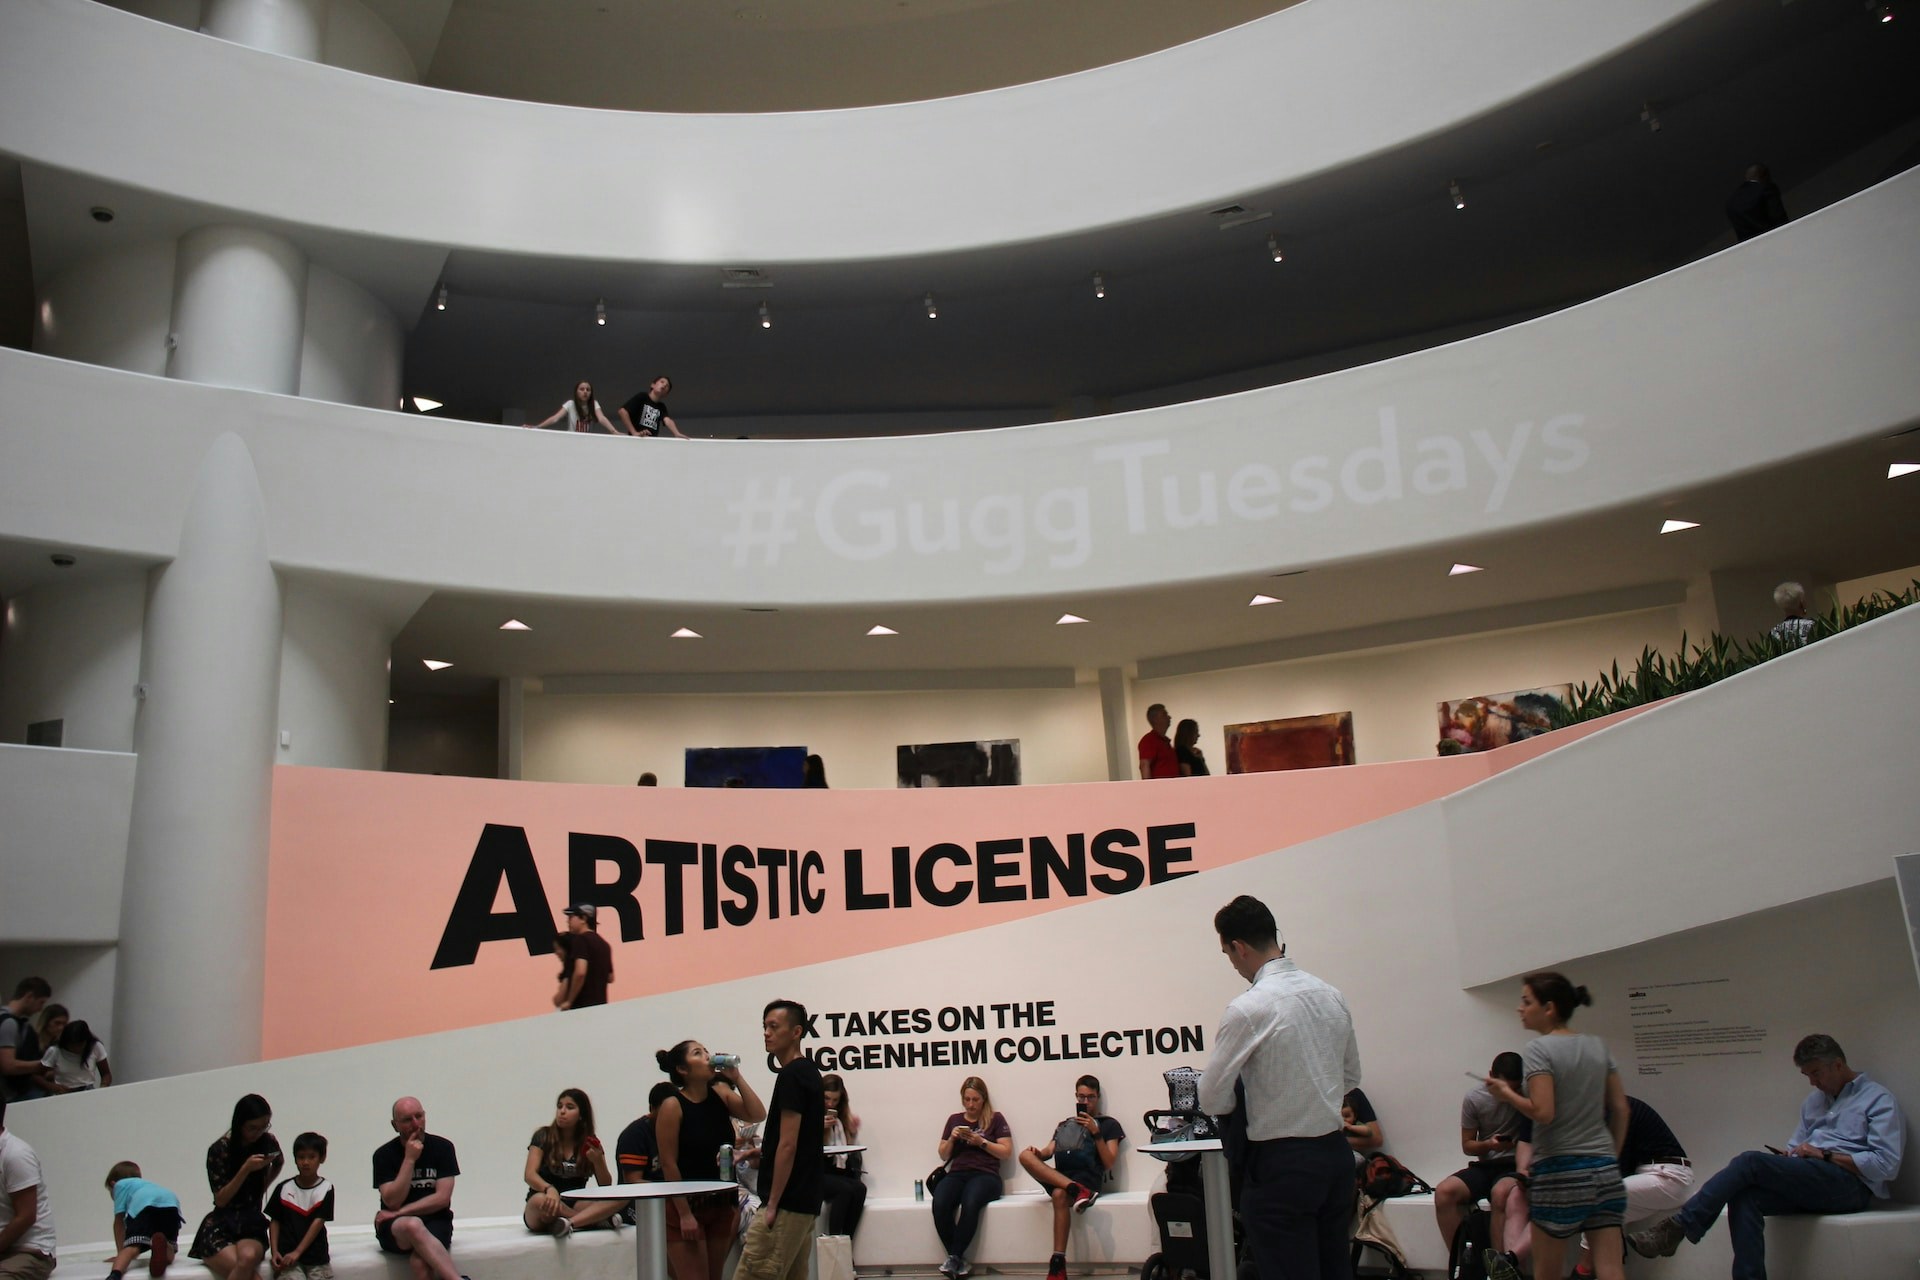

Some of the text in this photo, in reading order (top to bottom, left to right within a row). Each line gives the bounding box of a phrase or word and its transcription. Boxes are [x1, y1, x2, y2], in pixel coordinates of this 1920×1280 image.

[429, 822, 1200, 970] ARTISTIC LICENSE
[824, 1007, 933, 1038] TAKES
[937, 1005, 986, 1033] ON
[990, 1000, 1056, 1029] THE
[993, 1025, 1205, 1064] COLLECTION
